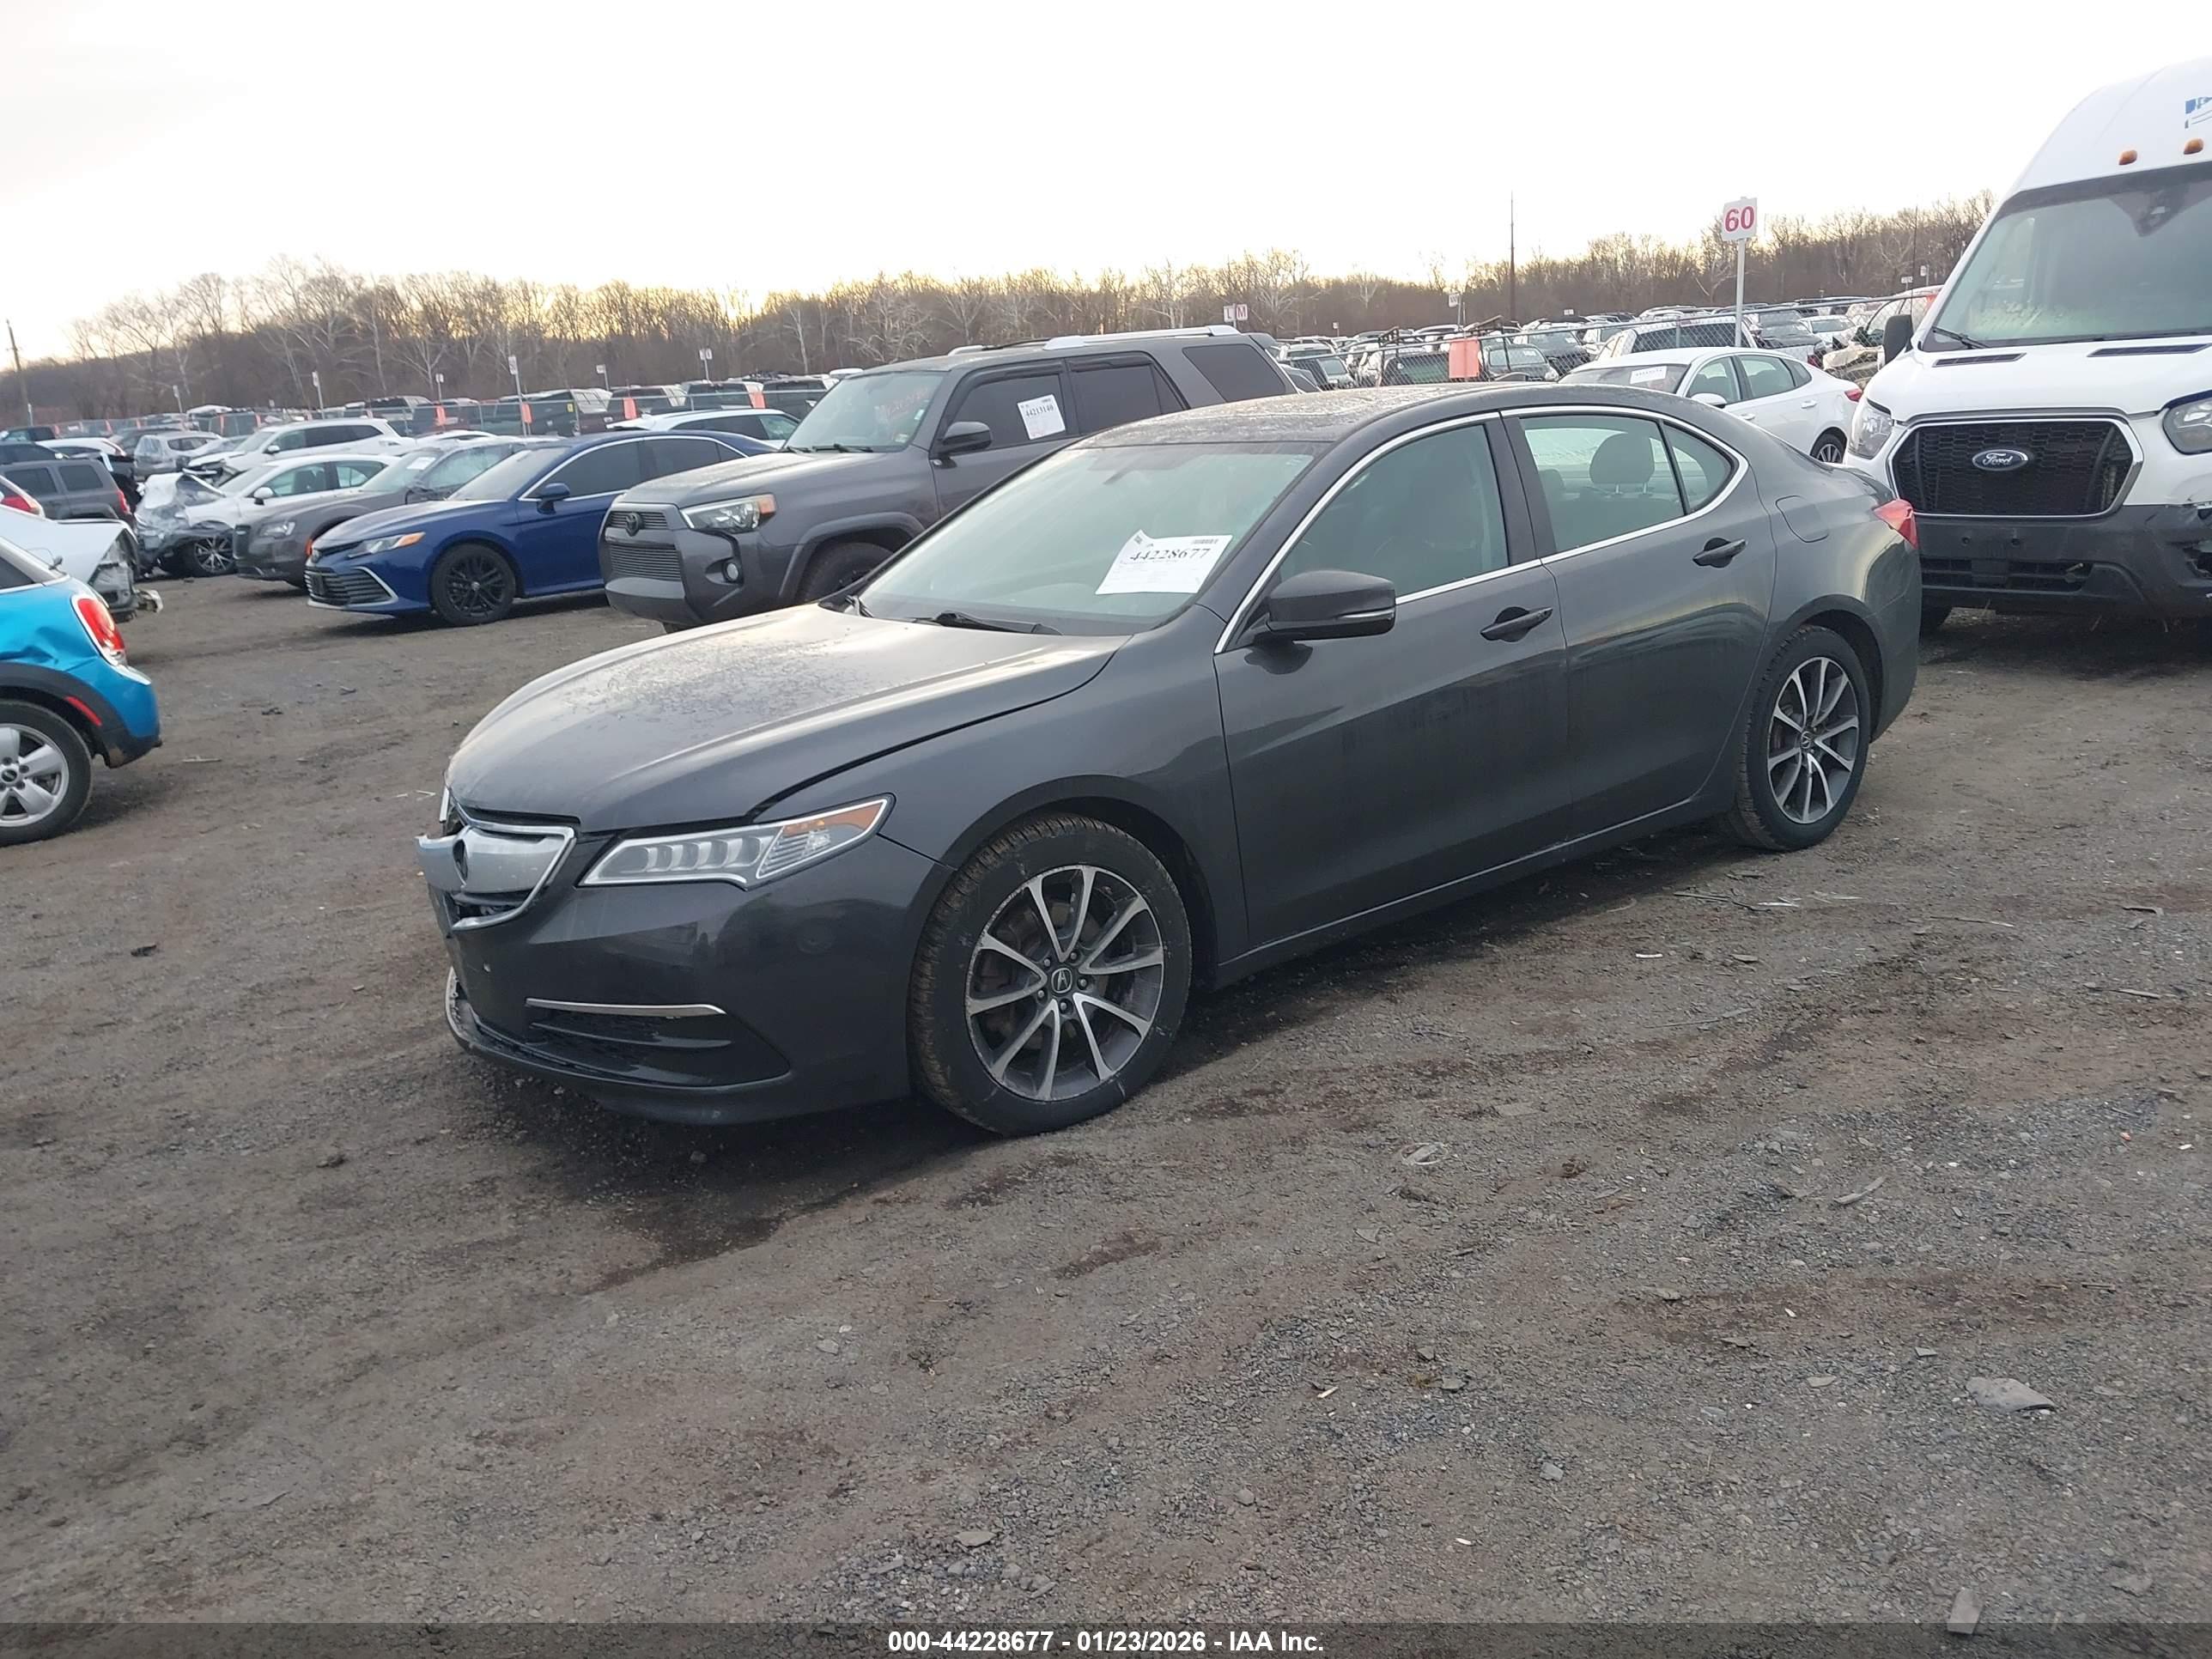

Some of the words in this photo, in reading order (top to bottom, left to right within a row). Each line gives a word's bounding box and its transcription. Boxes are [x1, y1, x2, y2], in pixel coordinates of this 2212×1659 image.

[1725, 206, 1754, 232] 60
[1237, 307, 1246, 319] M
[1982, 453, 2014, 465] Ford
[1129, 548, 1212, 561] 44228677
